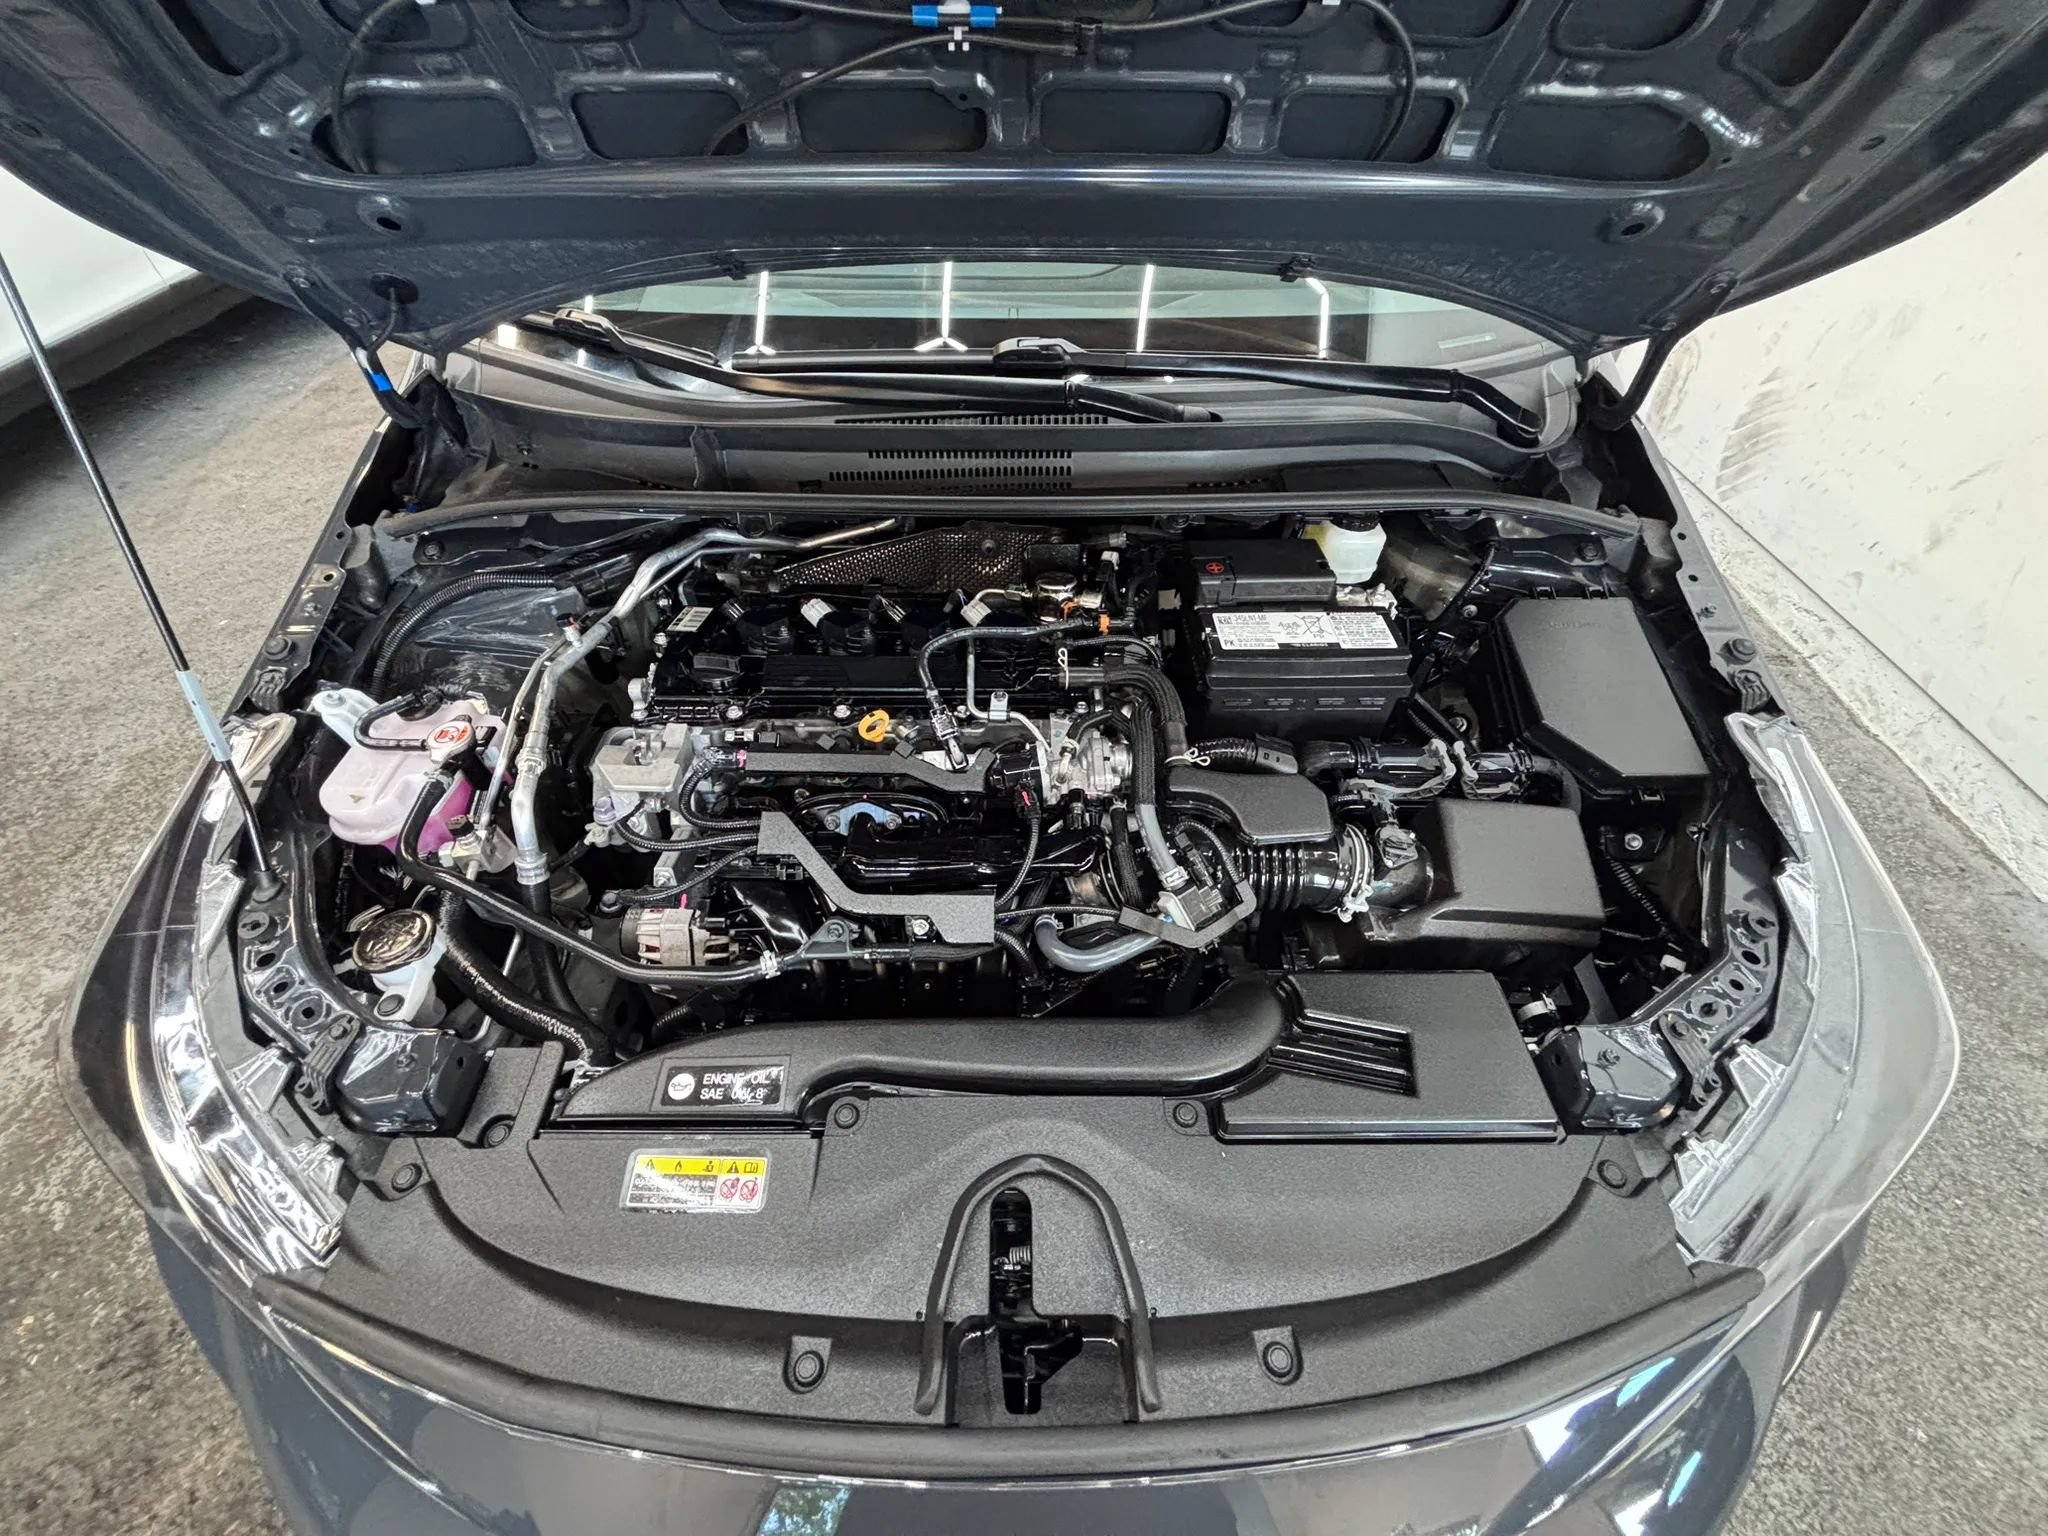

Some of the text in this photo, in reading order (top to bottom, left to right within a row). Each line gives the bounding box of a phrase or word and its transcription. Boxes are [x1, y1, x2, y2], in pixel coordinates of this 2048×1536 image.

[702, 1070, 771, 1085] ENGINE OIL
[700, 1087, 725, 1100] SAE
